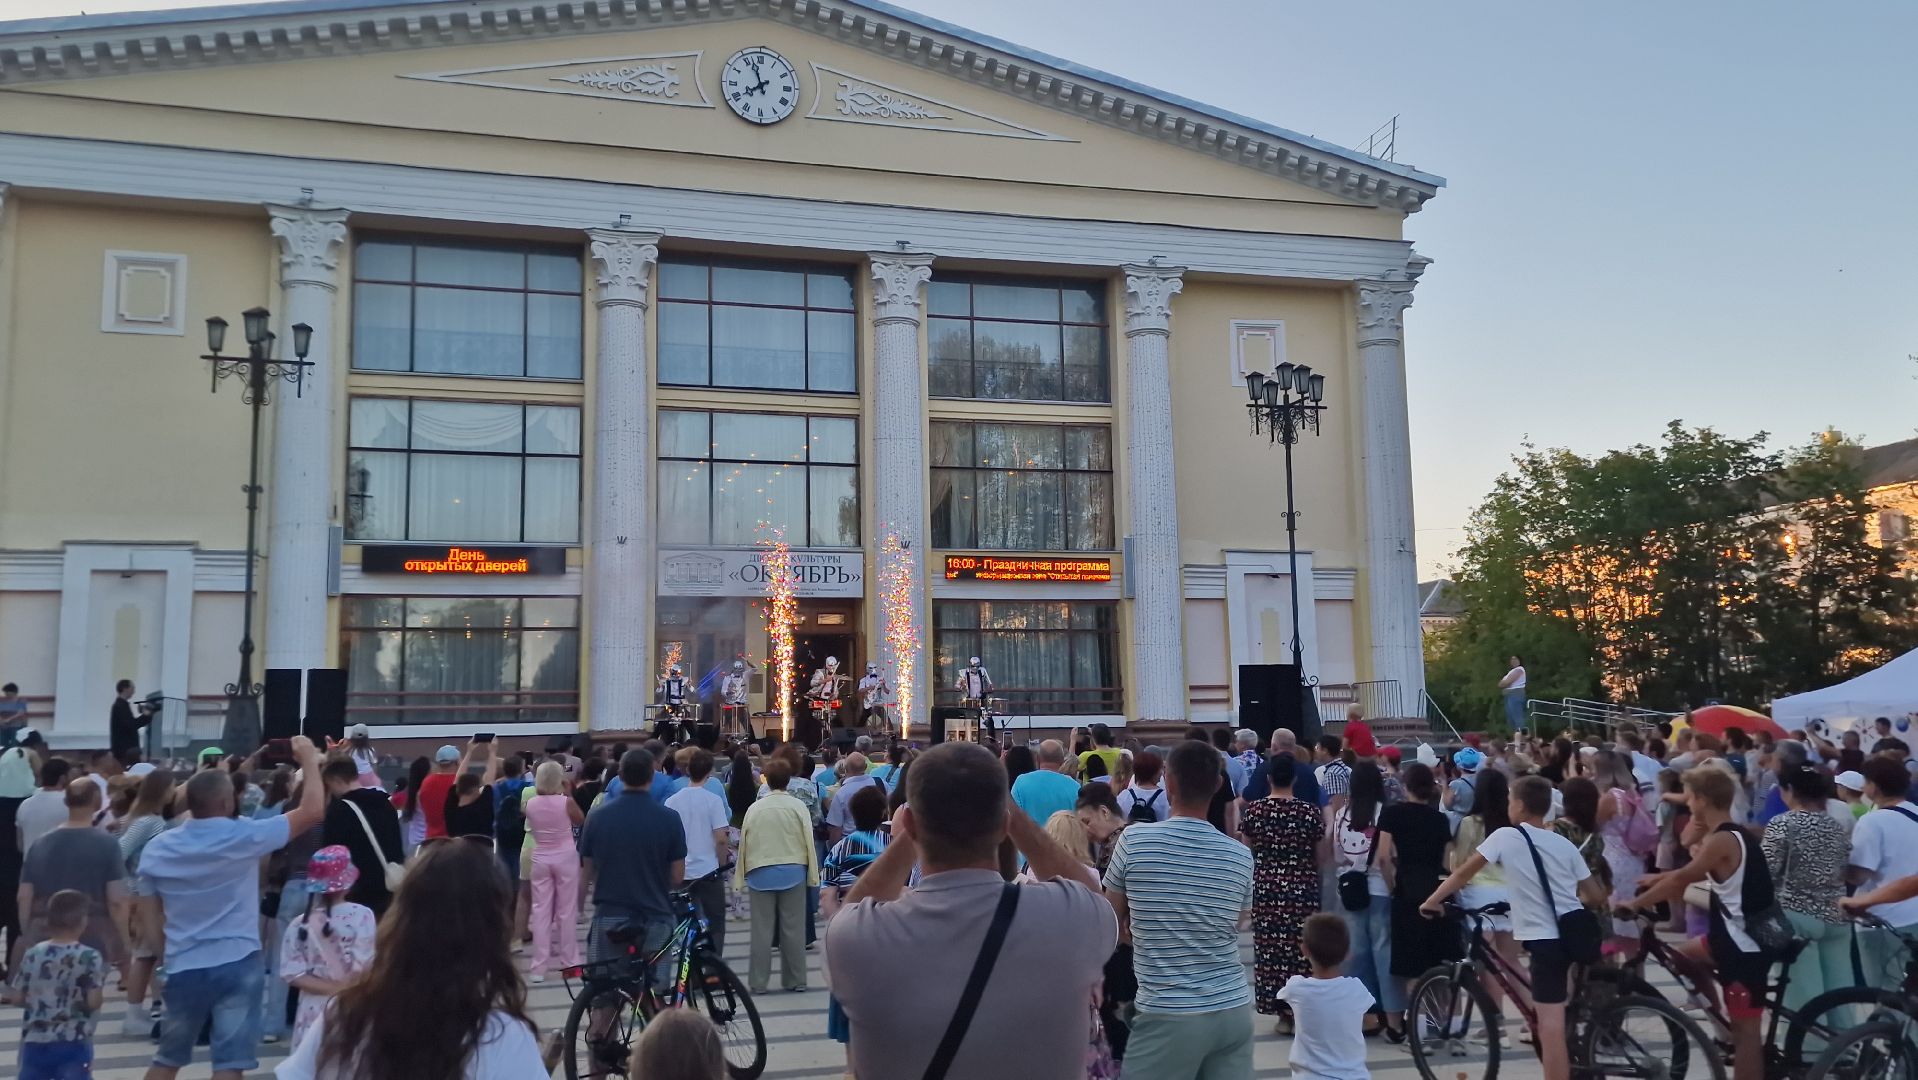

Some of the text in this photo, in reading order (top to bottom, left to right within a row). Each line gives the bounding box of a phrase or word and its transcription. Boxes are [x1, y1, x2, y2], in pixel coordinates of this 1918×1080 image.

[448, 548, 485, 561] День
[791, 554, 841, 564] КУЛЬТУРЫ
[404, 559, 527, 573] открытых дверей
[947, 558, 975, 569] 16:00
[984, 559, 1052, 572] Праздничная
[1054, 562, 1109, 573] программа
[729, 564, 860, 583] «ОКЯБРЬ»
